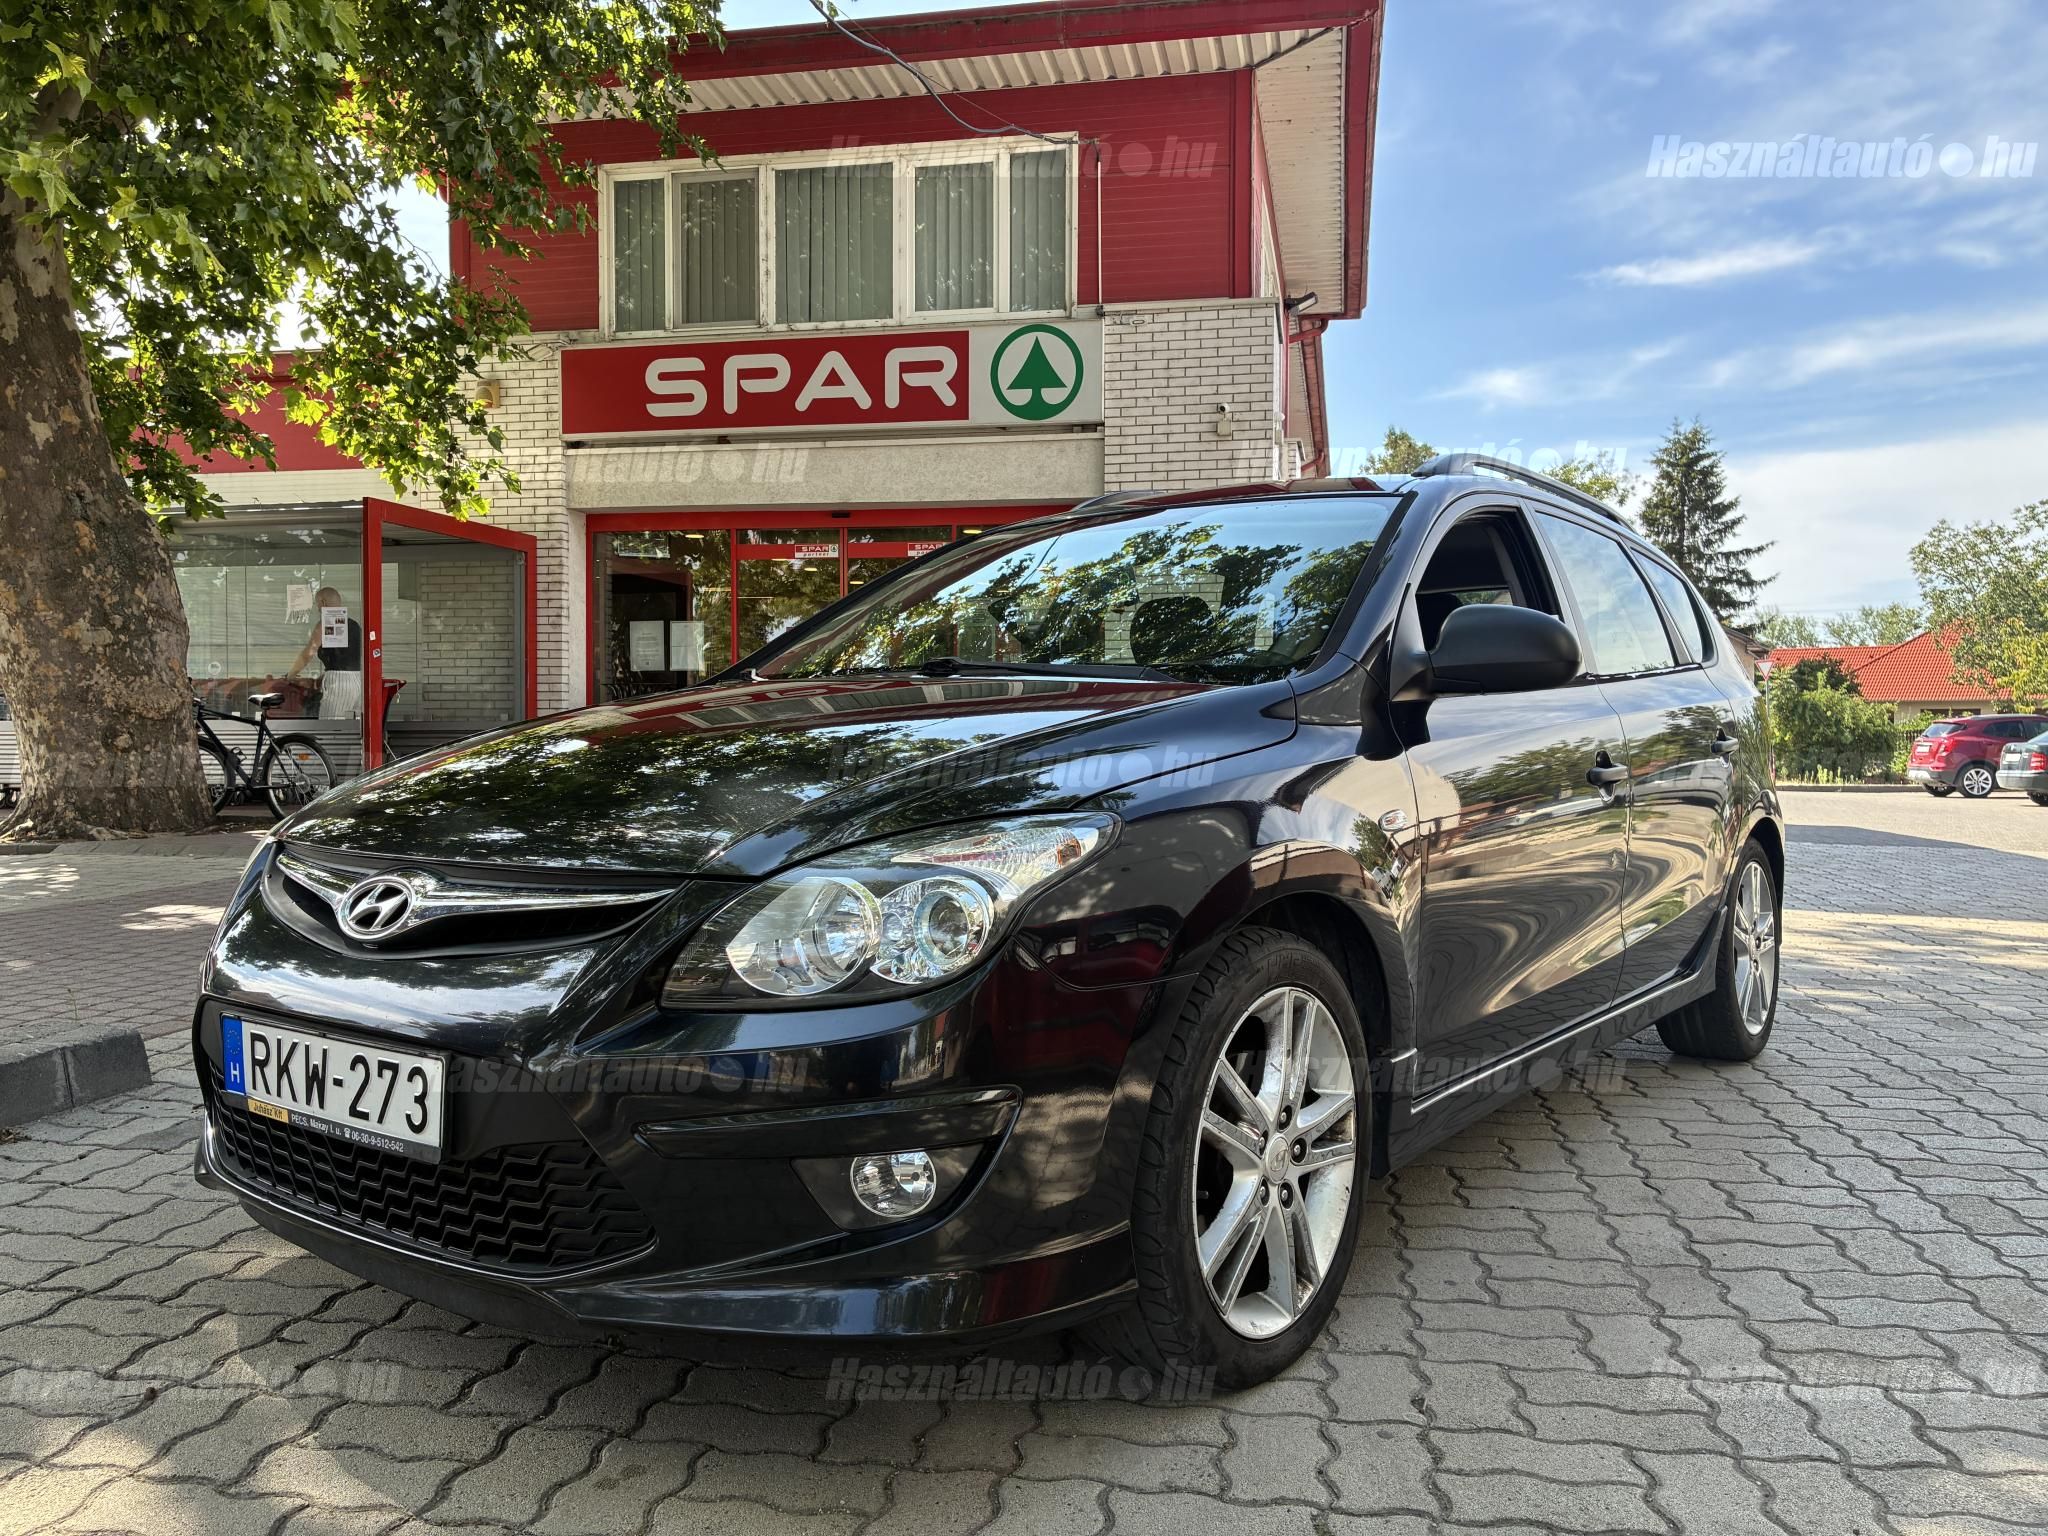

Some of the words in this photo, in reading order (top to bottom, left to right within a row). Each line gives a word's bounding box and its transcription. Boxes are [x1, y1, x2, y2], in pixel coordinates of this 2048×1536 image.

[645, 345, 958, 418] SPAR
[230, 1061, 241, 1084] H
[249, 1029, 429, 1135] RKW-273
